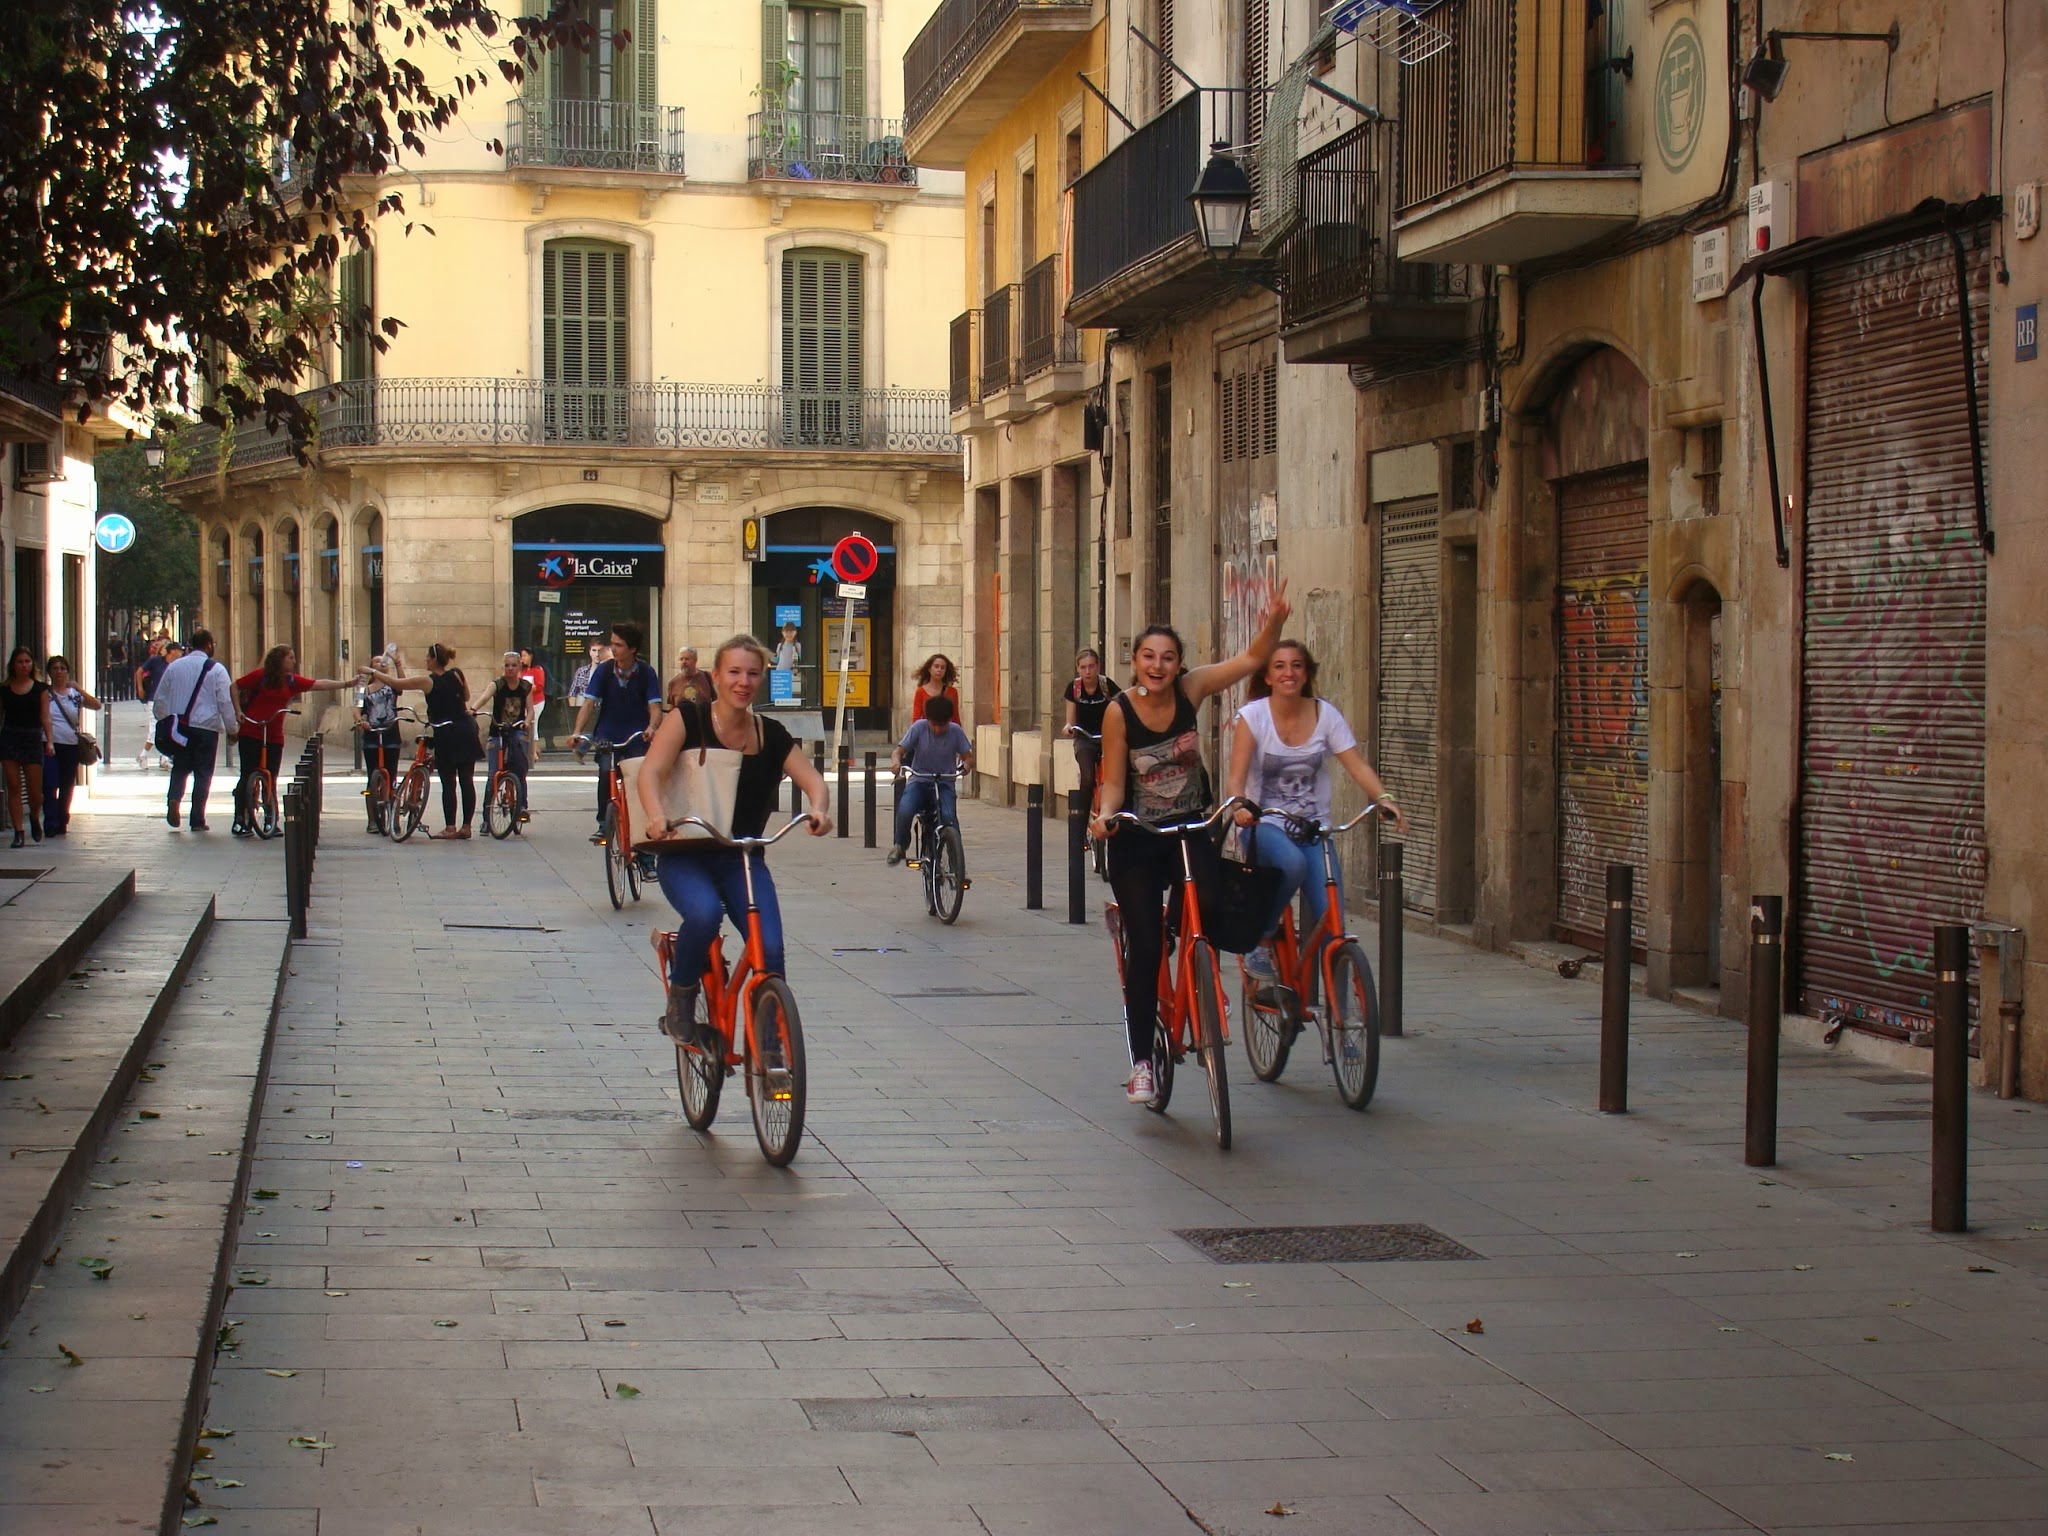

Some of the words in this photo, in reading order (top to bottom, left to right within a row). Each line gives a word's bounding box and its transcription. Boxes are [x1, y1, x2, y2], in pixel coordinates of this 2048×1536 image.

[2017, 195, 2032, 228] 24
[2017, 318, 2035, 347] RB
[586, 471, 596, 480] 44
